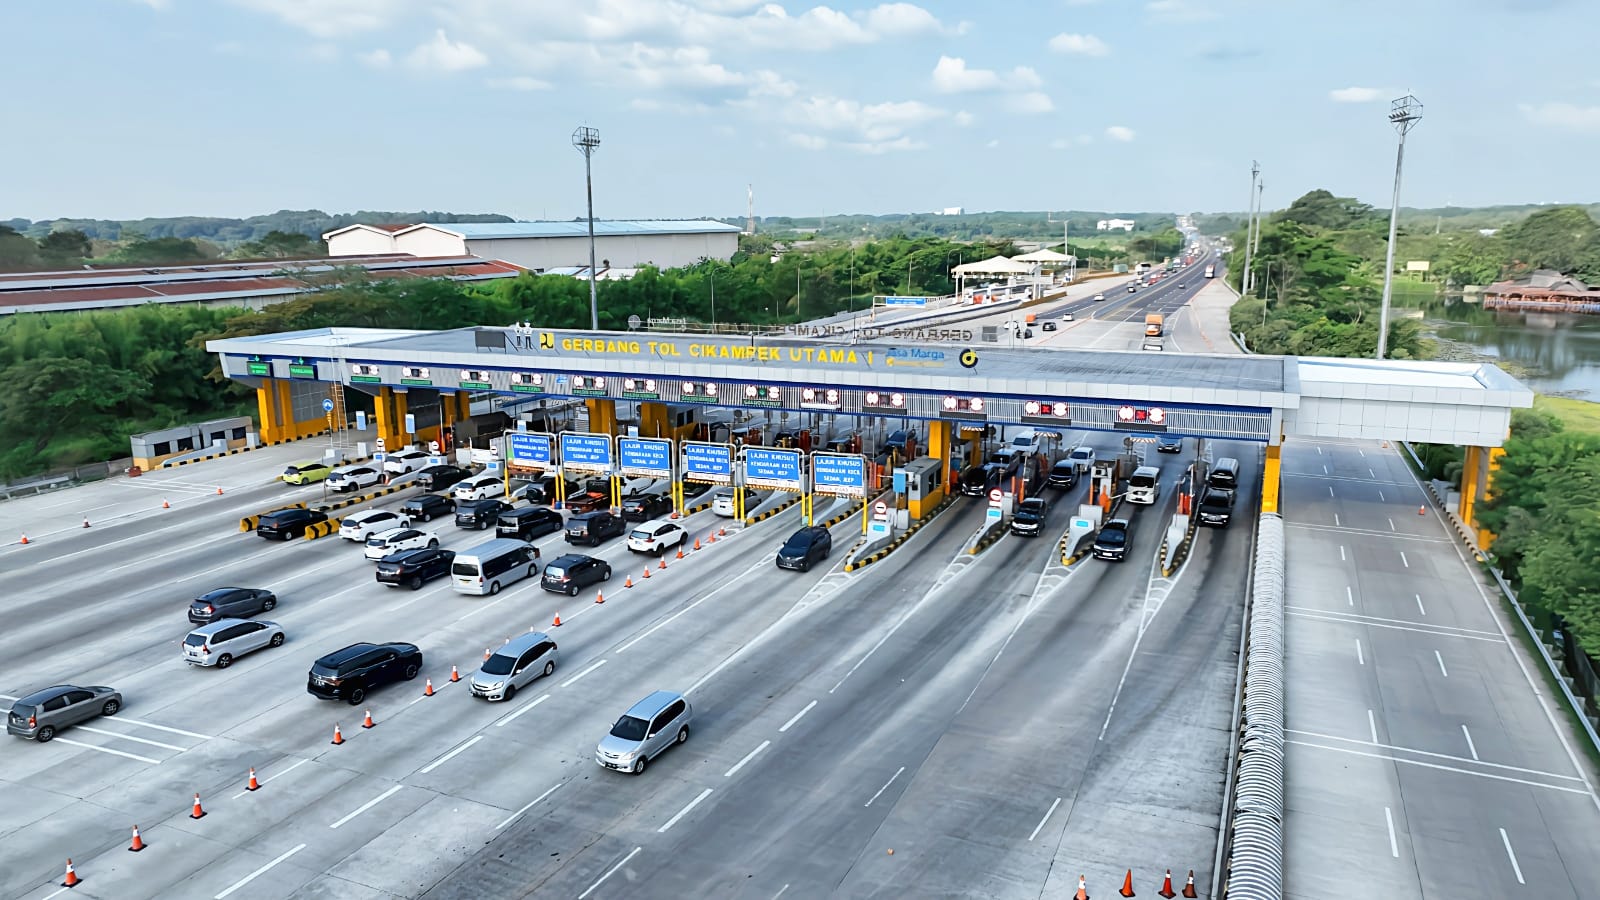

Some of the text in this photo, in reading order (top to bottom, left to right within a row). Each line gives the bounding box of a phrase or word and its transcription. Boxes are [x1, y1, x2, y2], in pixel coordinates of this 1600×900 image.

[562, 339, 640, 354] GERBANG
[648, 342, 681, 356] TOL
[689, 343, 781, 361] CIKAMPEK
[789, 348, 858, 364] UTAMA
[911, 348, 944, 361] Marga
